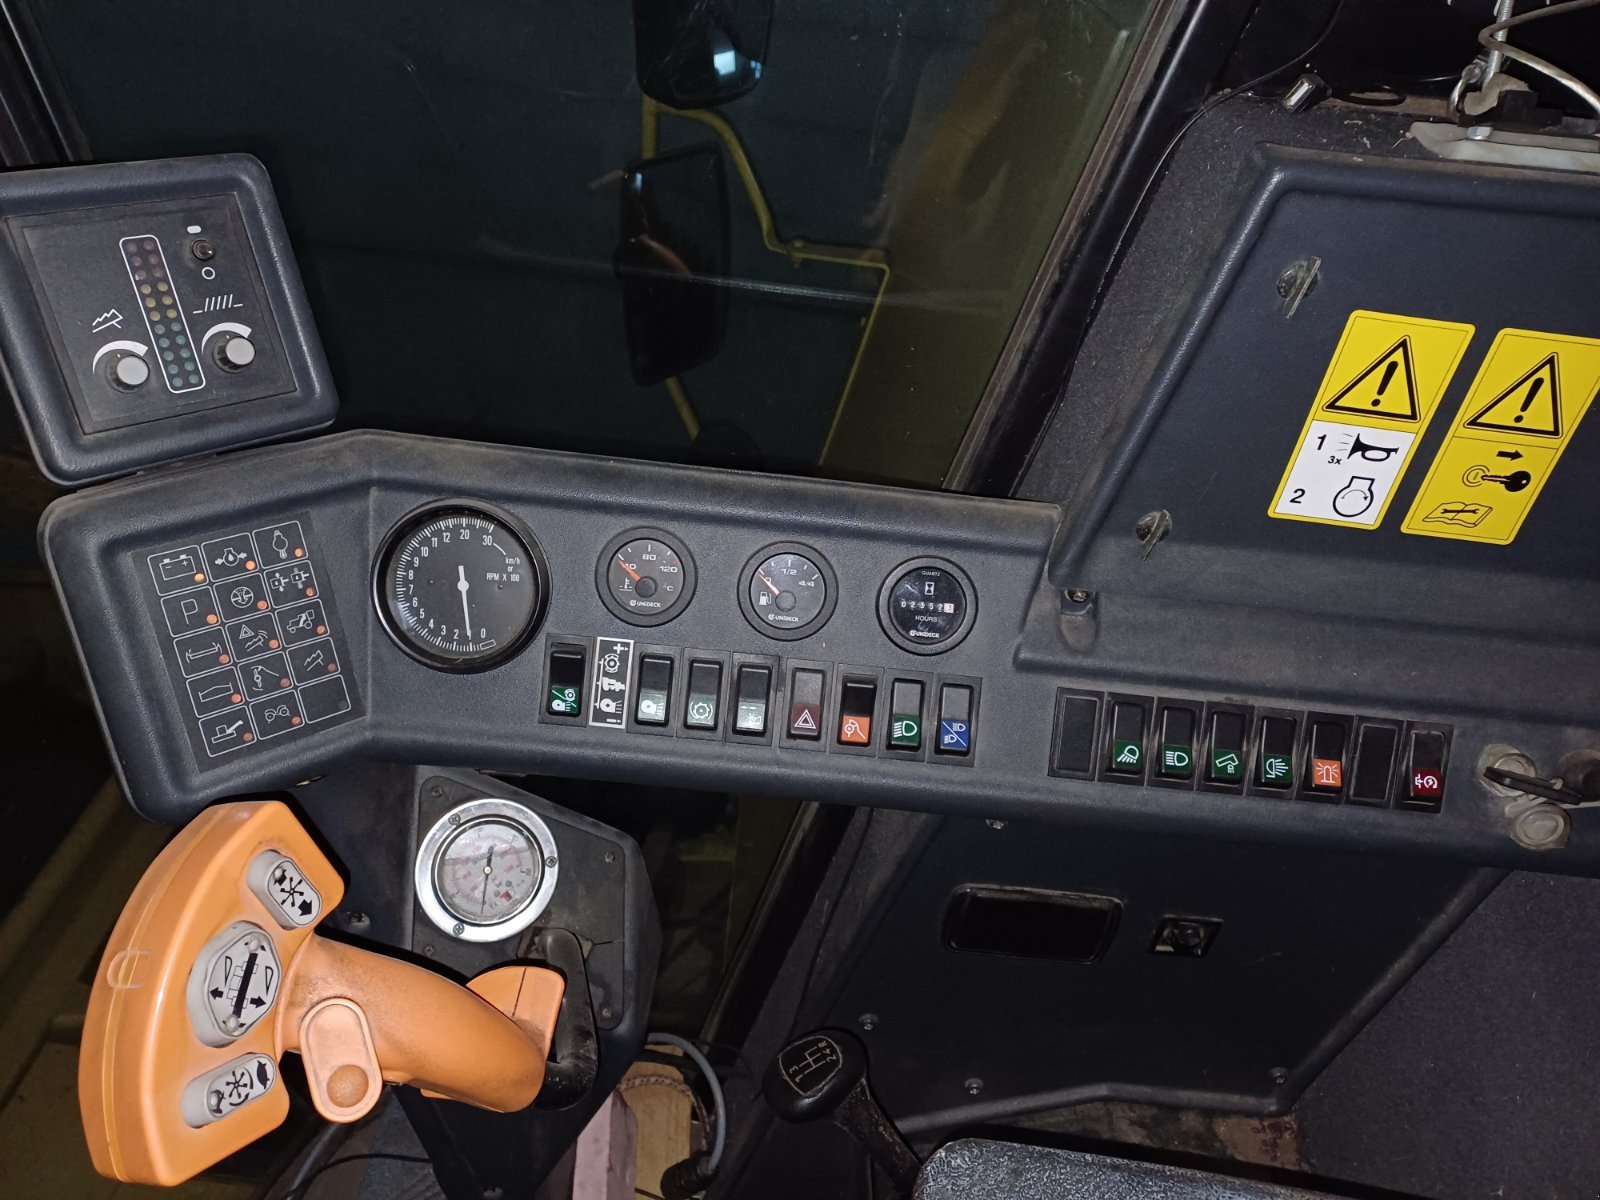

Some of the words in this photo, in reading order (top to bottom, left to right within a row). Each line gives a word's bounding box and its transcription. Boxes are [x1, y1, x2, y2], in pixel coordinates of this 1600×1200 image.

[1316, 433, 1328, 451] 1
[1327, 455, 1342, 465] 3x
[1289, 488, 1306, 504] 2
[443, 532, 450, 543] 12
[460, 529, 470, 540] 20
[432, 537, 438, 548] 11
[482, 535, 493, 546] 30
[421, 547, 428, 557] 10
[413, 557, 419, 567] 9
[408, 570, 414, 580] 8
[486, 572, 500, 580] RPM
[409, 585, 414, 595] 7
[412, 597, 418, 608] 6
[419, 608, 425, 619] 5
[428, 618, 434, 629] 4
[440, 624, 446, 636] 3
[454, 628, 459, 640] 2
[480, 628, 486, 638] 0
